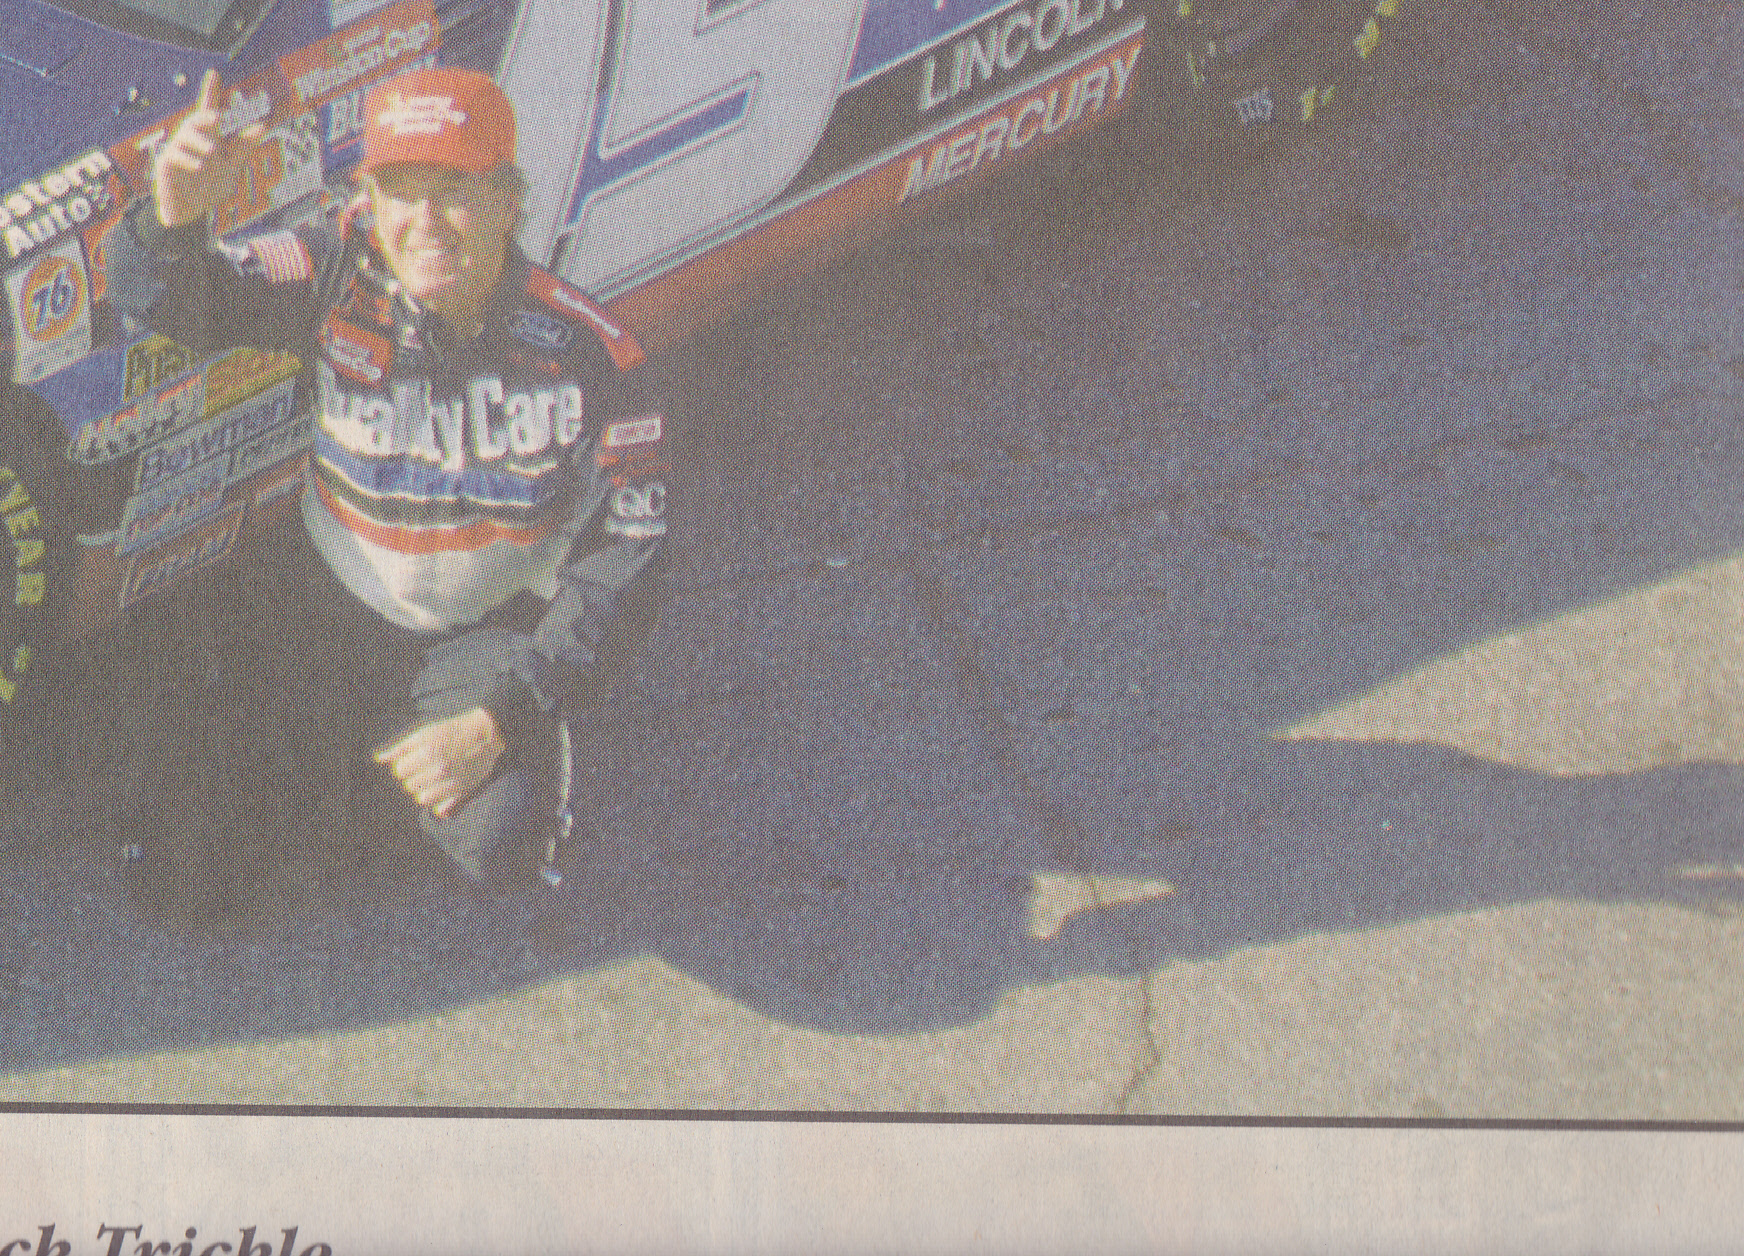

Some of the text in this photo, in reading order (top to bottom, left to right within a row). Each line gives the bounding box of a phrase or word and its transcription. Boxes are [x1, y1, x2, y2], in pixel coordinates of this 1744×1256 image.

[384, 21, 431, 58] Cup
[900, 44, 1143, 203] MERCURY
[5, 194, 92, 259] Auto
[30, 265, 76, 330] 76
[467, 376, 583, 461] Care
